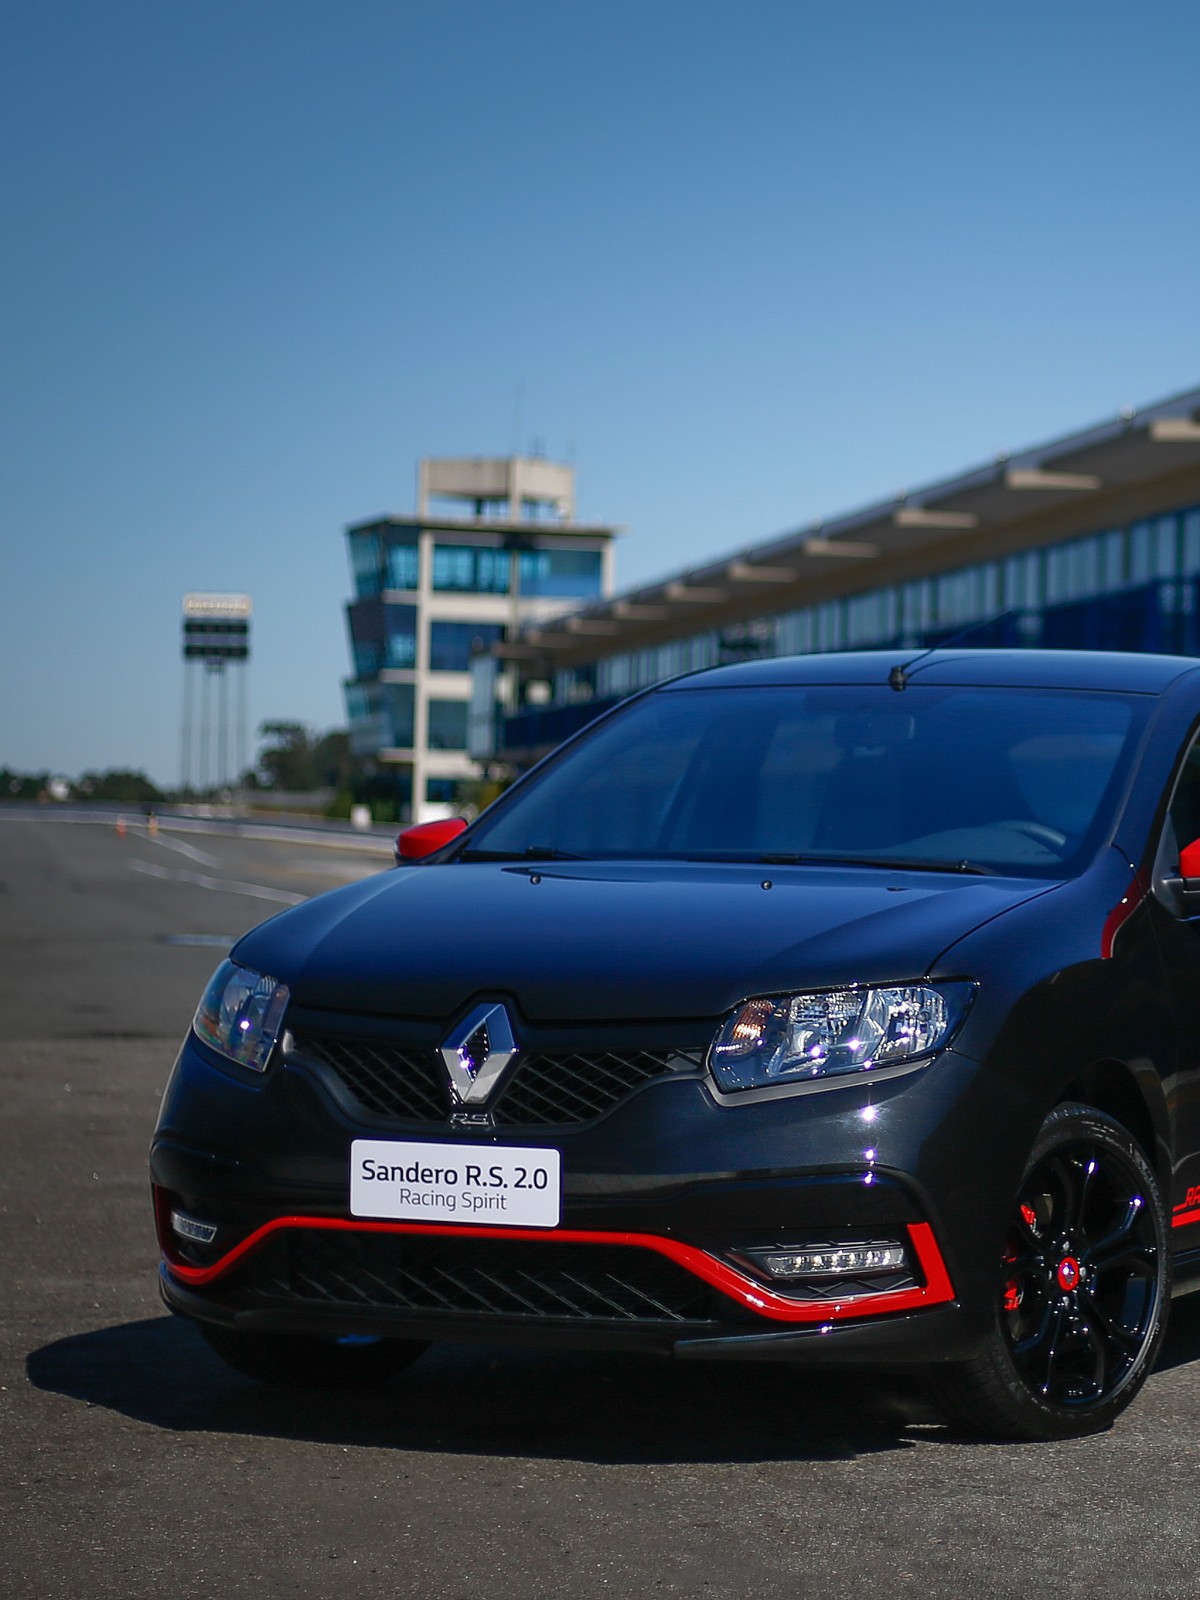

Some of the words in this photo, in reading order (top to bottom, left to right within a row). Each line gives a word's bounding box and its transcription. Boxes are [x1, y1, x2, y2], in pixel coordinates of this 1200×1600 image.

[361, 1159, 458, 1186] Sandero
[465, 1165, 508, 1188] R.S.
[514, 1167, 548, 1190] 2.0
[399, 1188, 456, 1212] Racing
[461, 1191, 507, 1212] Spirit
